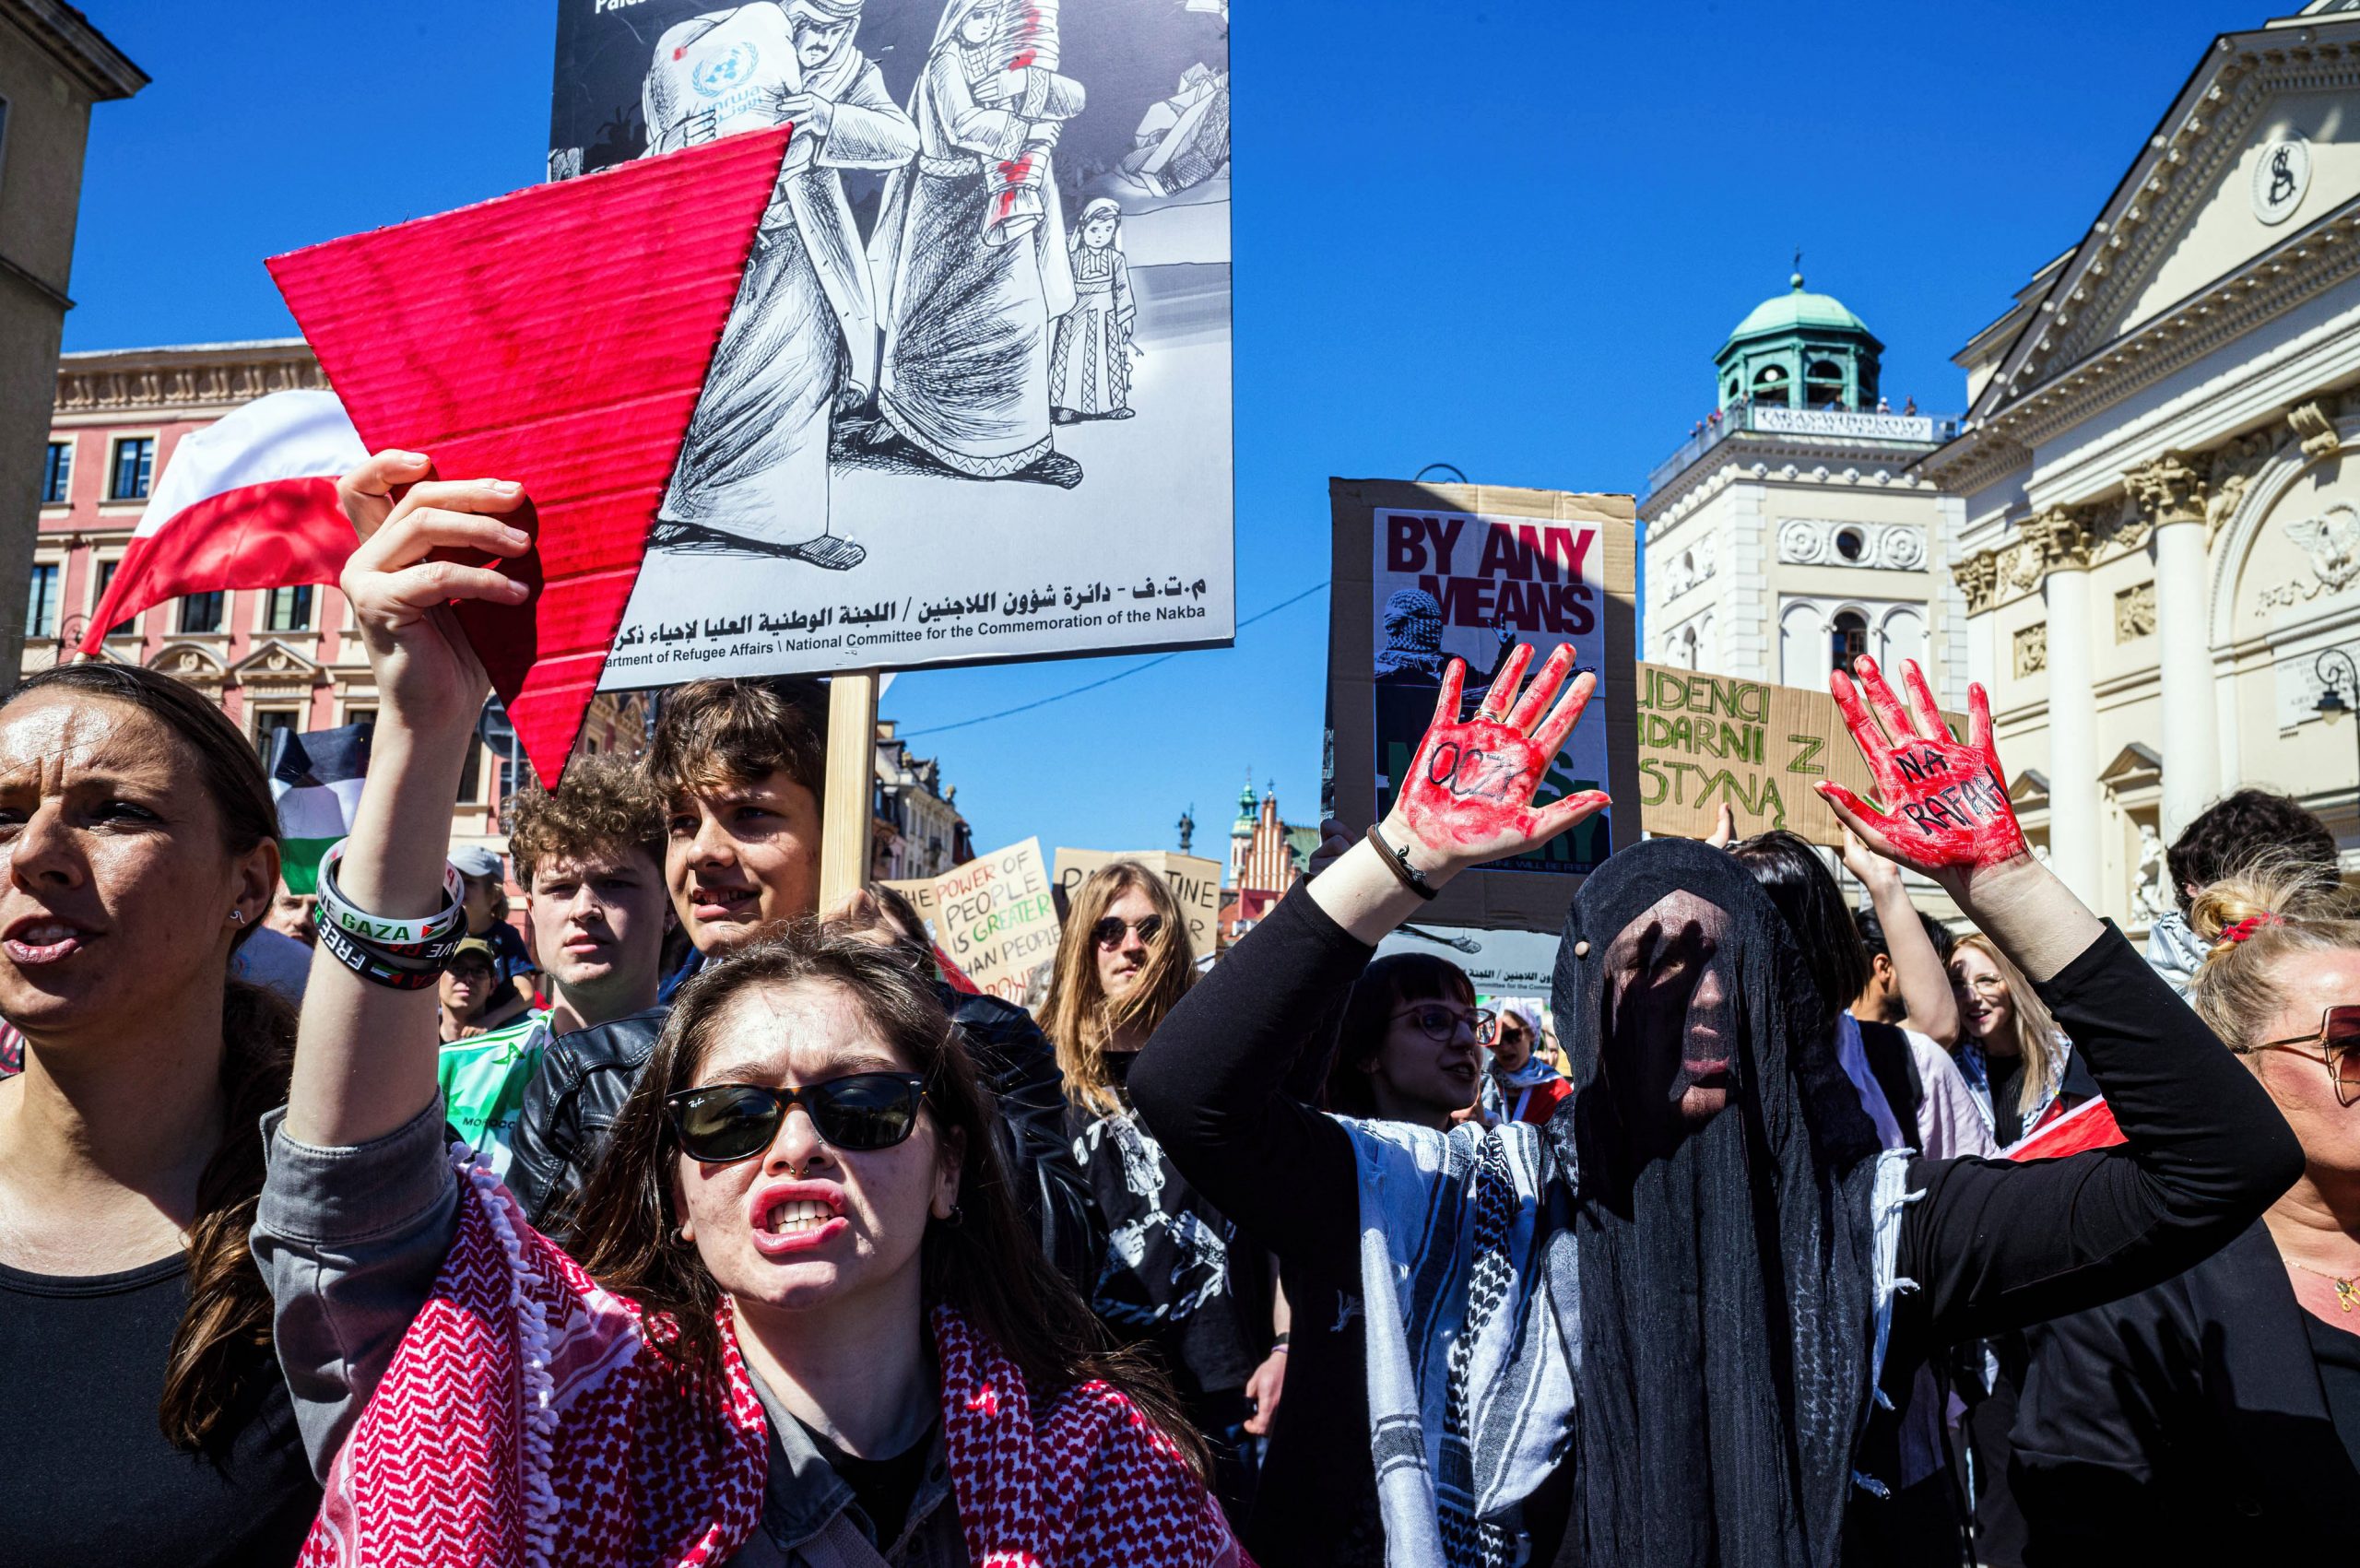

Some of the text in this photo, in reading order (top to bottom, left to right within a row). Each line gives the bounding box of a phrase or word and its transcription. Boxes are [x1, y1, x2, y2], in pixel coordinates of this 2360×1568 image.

[1386, 515, 1596, 584] BY ANY
[839, 600, 896, 629] اللجنة
[1003, 584, 1056, 616] شؤون
[1064, 582, 1111, 610] دائرة
[1419, 574, 1595, 635] MEANS
[606, 653, 653, 667] artment
[656, 650, 669, 663] of
[673, 645, 726, 662] Refugee
[729, 641, 773, 655] Affairs
[785, 634, 842, 652] National
[846, 629, 922, 647] Committee
[926, 626, 947, 640] for
[950, 623, 974, 638] the
[977, 614, 1103, 636] Commemoration
[1107, 611, 1124, 624] of
[1127, 608, 1151, 623] the
[1156, 604, 1207, 621] Nakba
[615, 624, 644, 652] ذكر
[650, 619, 698, 646] لإحياء
[703, 614, 753, 643] العليا
[759, 607, 832, 636] الوطنية
[1637, 668, 1770, 725] UDENCI
[1637, 712, 1825, 775] IDARNI Z
[1897, 749, 1948, 784] NA
[1639, 758, 1788, 831] STYNĄ
[1903, 765, 2011, 836] RAFAH
[936, 864, 997, 903] POWER
[1003, 850, 1029, 874] OF
[1063, 867, 1216, 908] PTINE
[946, 871, 1040, 931] PEOPLE
[319, 917, 366, 971] FREE
[342, 913, 410, 940] GAZA
[952, 893, 1051, 954] IS GREATER
[963, 948, 997, 978] HAN
[463, 1116, 515, 1129] MOROCC
